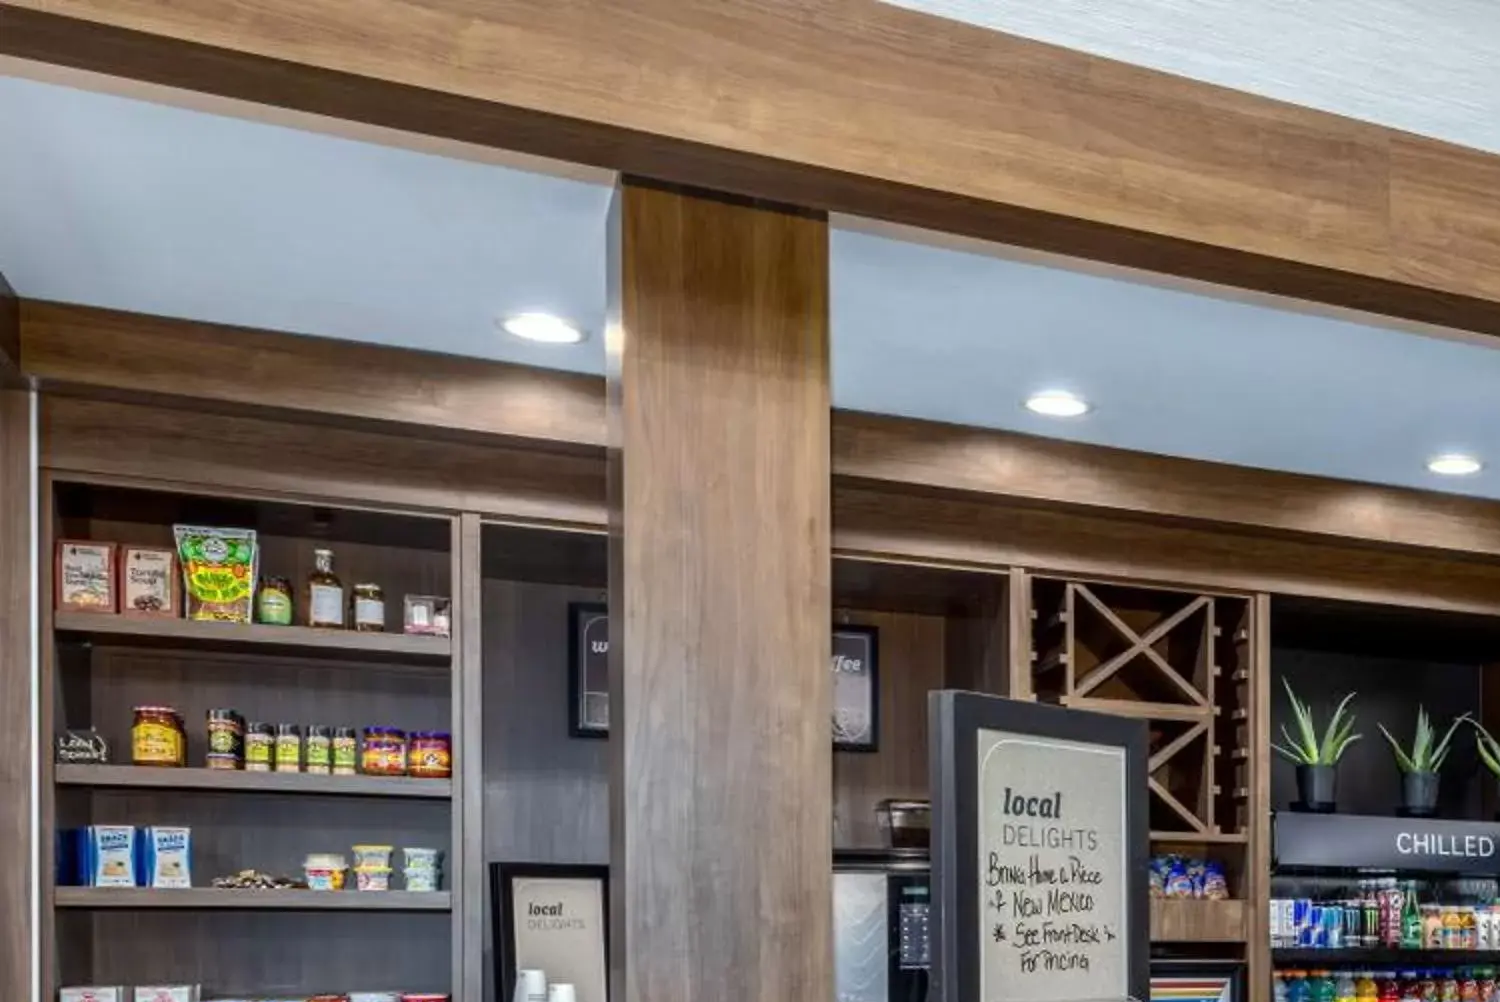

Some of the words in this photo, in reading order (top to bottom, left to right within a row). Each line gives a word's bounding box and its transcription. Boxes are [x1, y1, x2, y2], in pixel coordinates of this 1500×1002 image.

[1003, 787, 1061, 819] local
[1003, 823, 1098, 850] DELIGHTS
[1396, 832, 1495, 857] CHILLED
[528, 902, 562, 916] local
